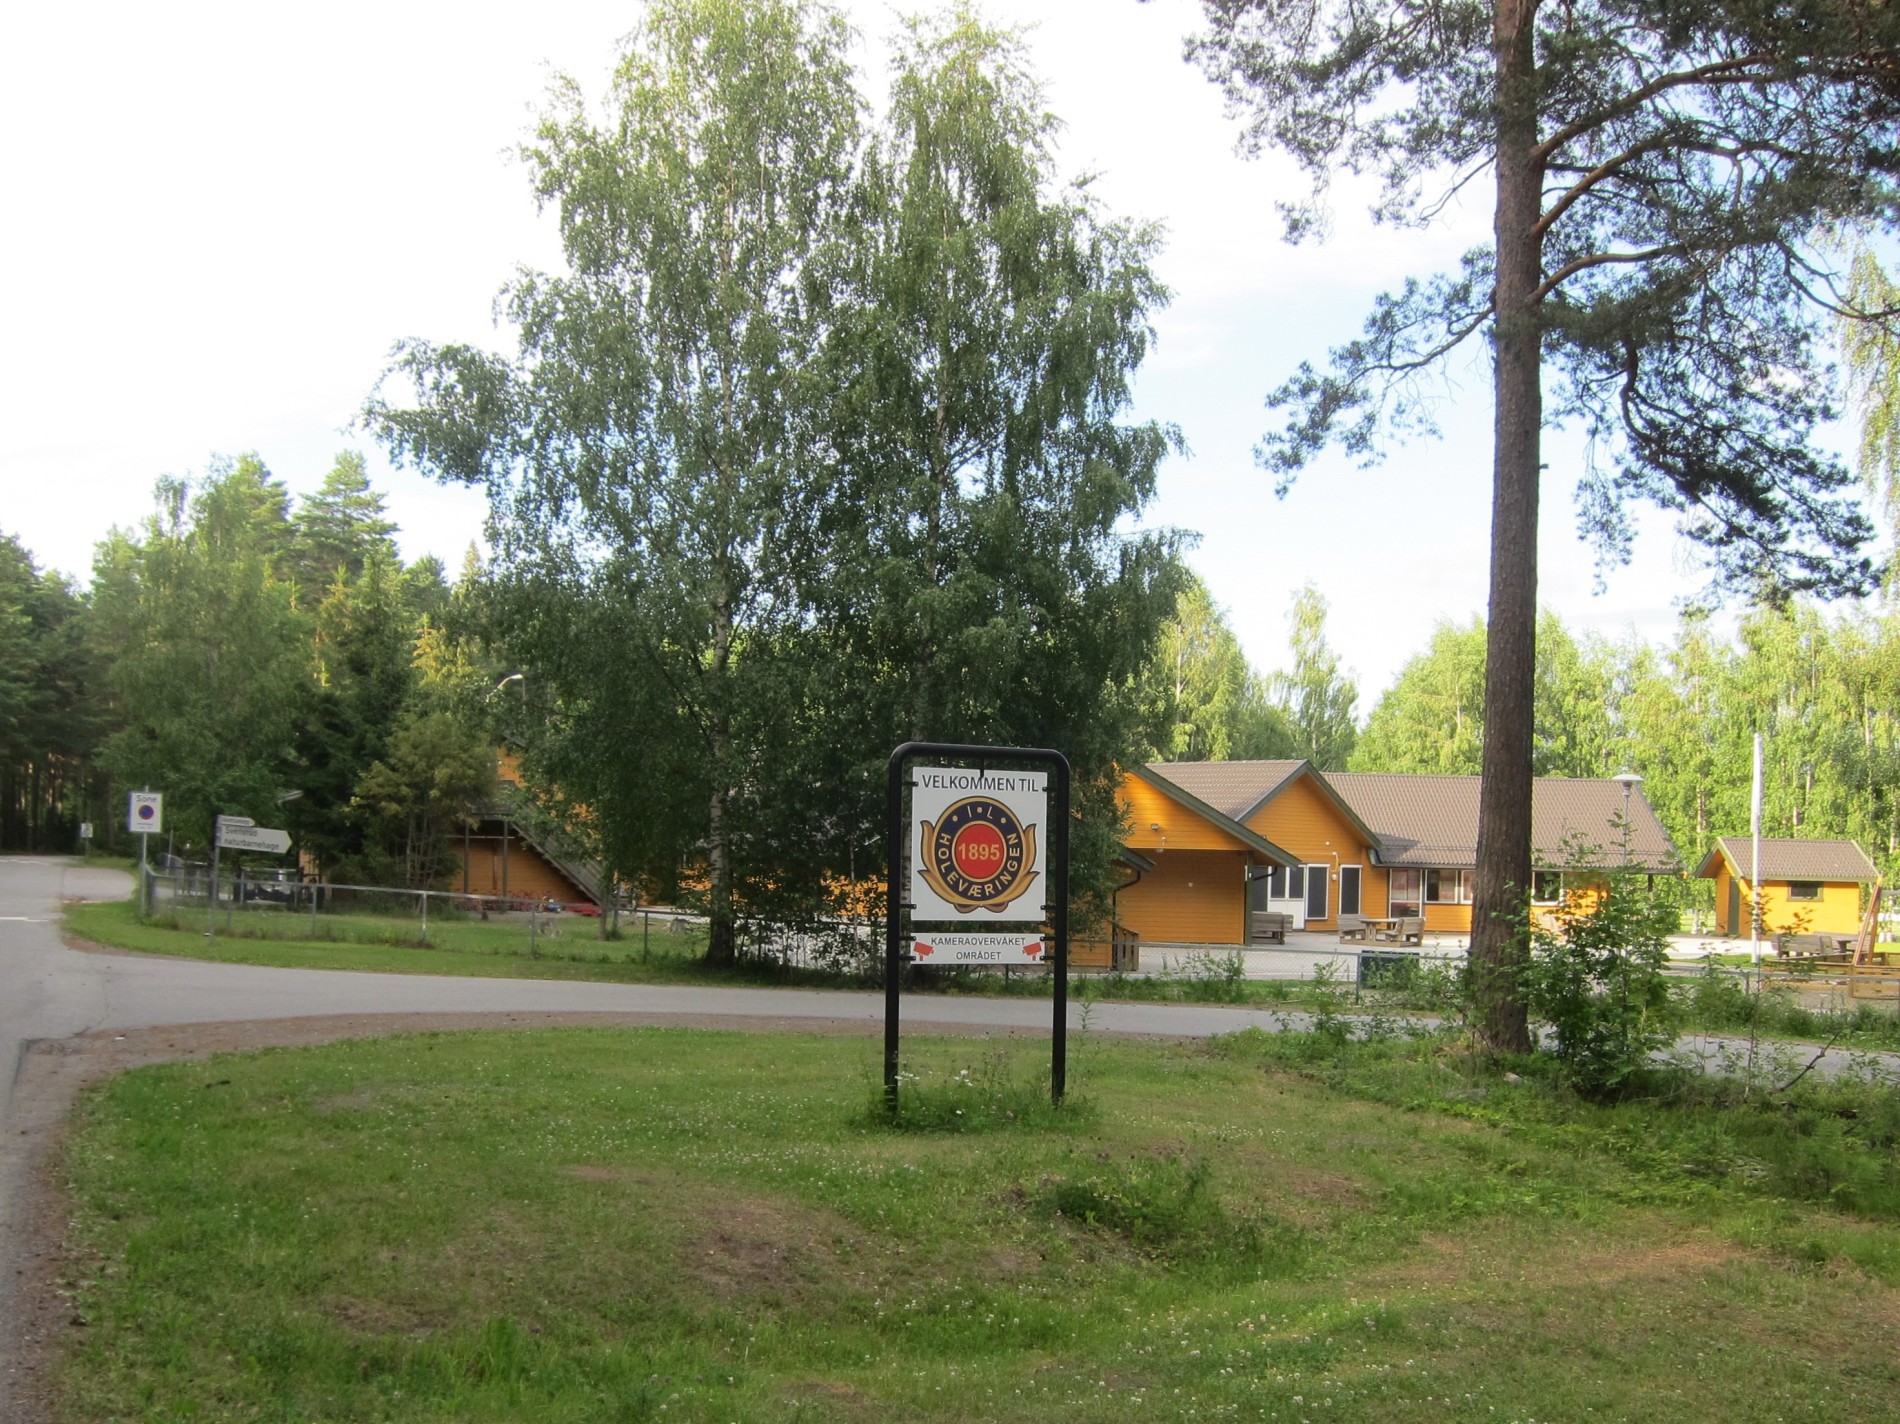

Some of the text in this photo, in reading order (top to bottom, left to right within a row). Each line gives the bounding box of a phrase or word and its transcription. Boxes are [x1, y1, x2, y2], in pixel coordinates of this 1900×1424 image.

[922, 774, 1039, 792] VELKOMMEN TIL
[136, 794, 157, 803] Sone
[959, 843, 1000, 861] 1895
[931, 936, 1026, 946] KAMERAOVERVÅKET
[955, 950, 1002, 960] OMRÅDET
